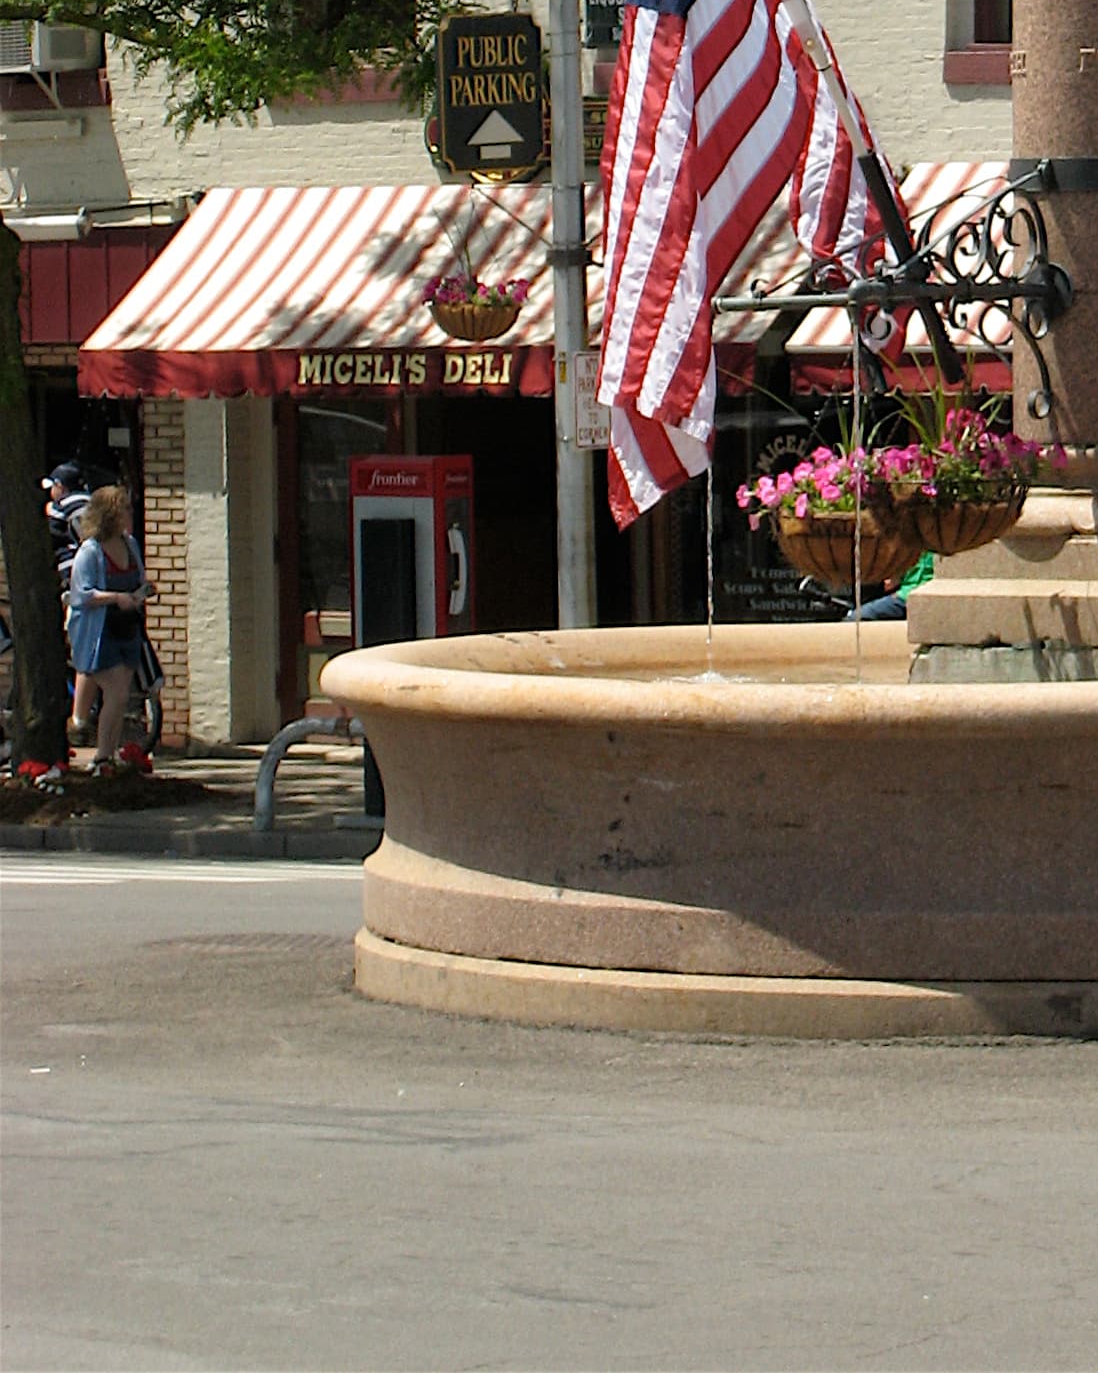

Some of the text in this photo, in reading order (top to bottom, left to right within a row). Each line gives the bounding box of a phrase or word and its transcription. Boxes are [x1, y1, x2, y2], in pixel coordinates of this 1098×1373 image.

[457, 34, 528, 68] PUBLIC
[451, 72, 537, 107] PARKING
[298, 352, 513, 385] MICELI'S DELI
[368, 469, 418, 489] frontier
